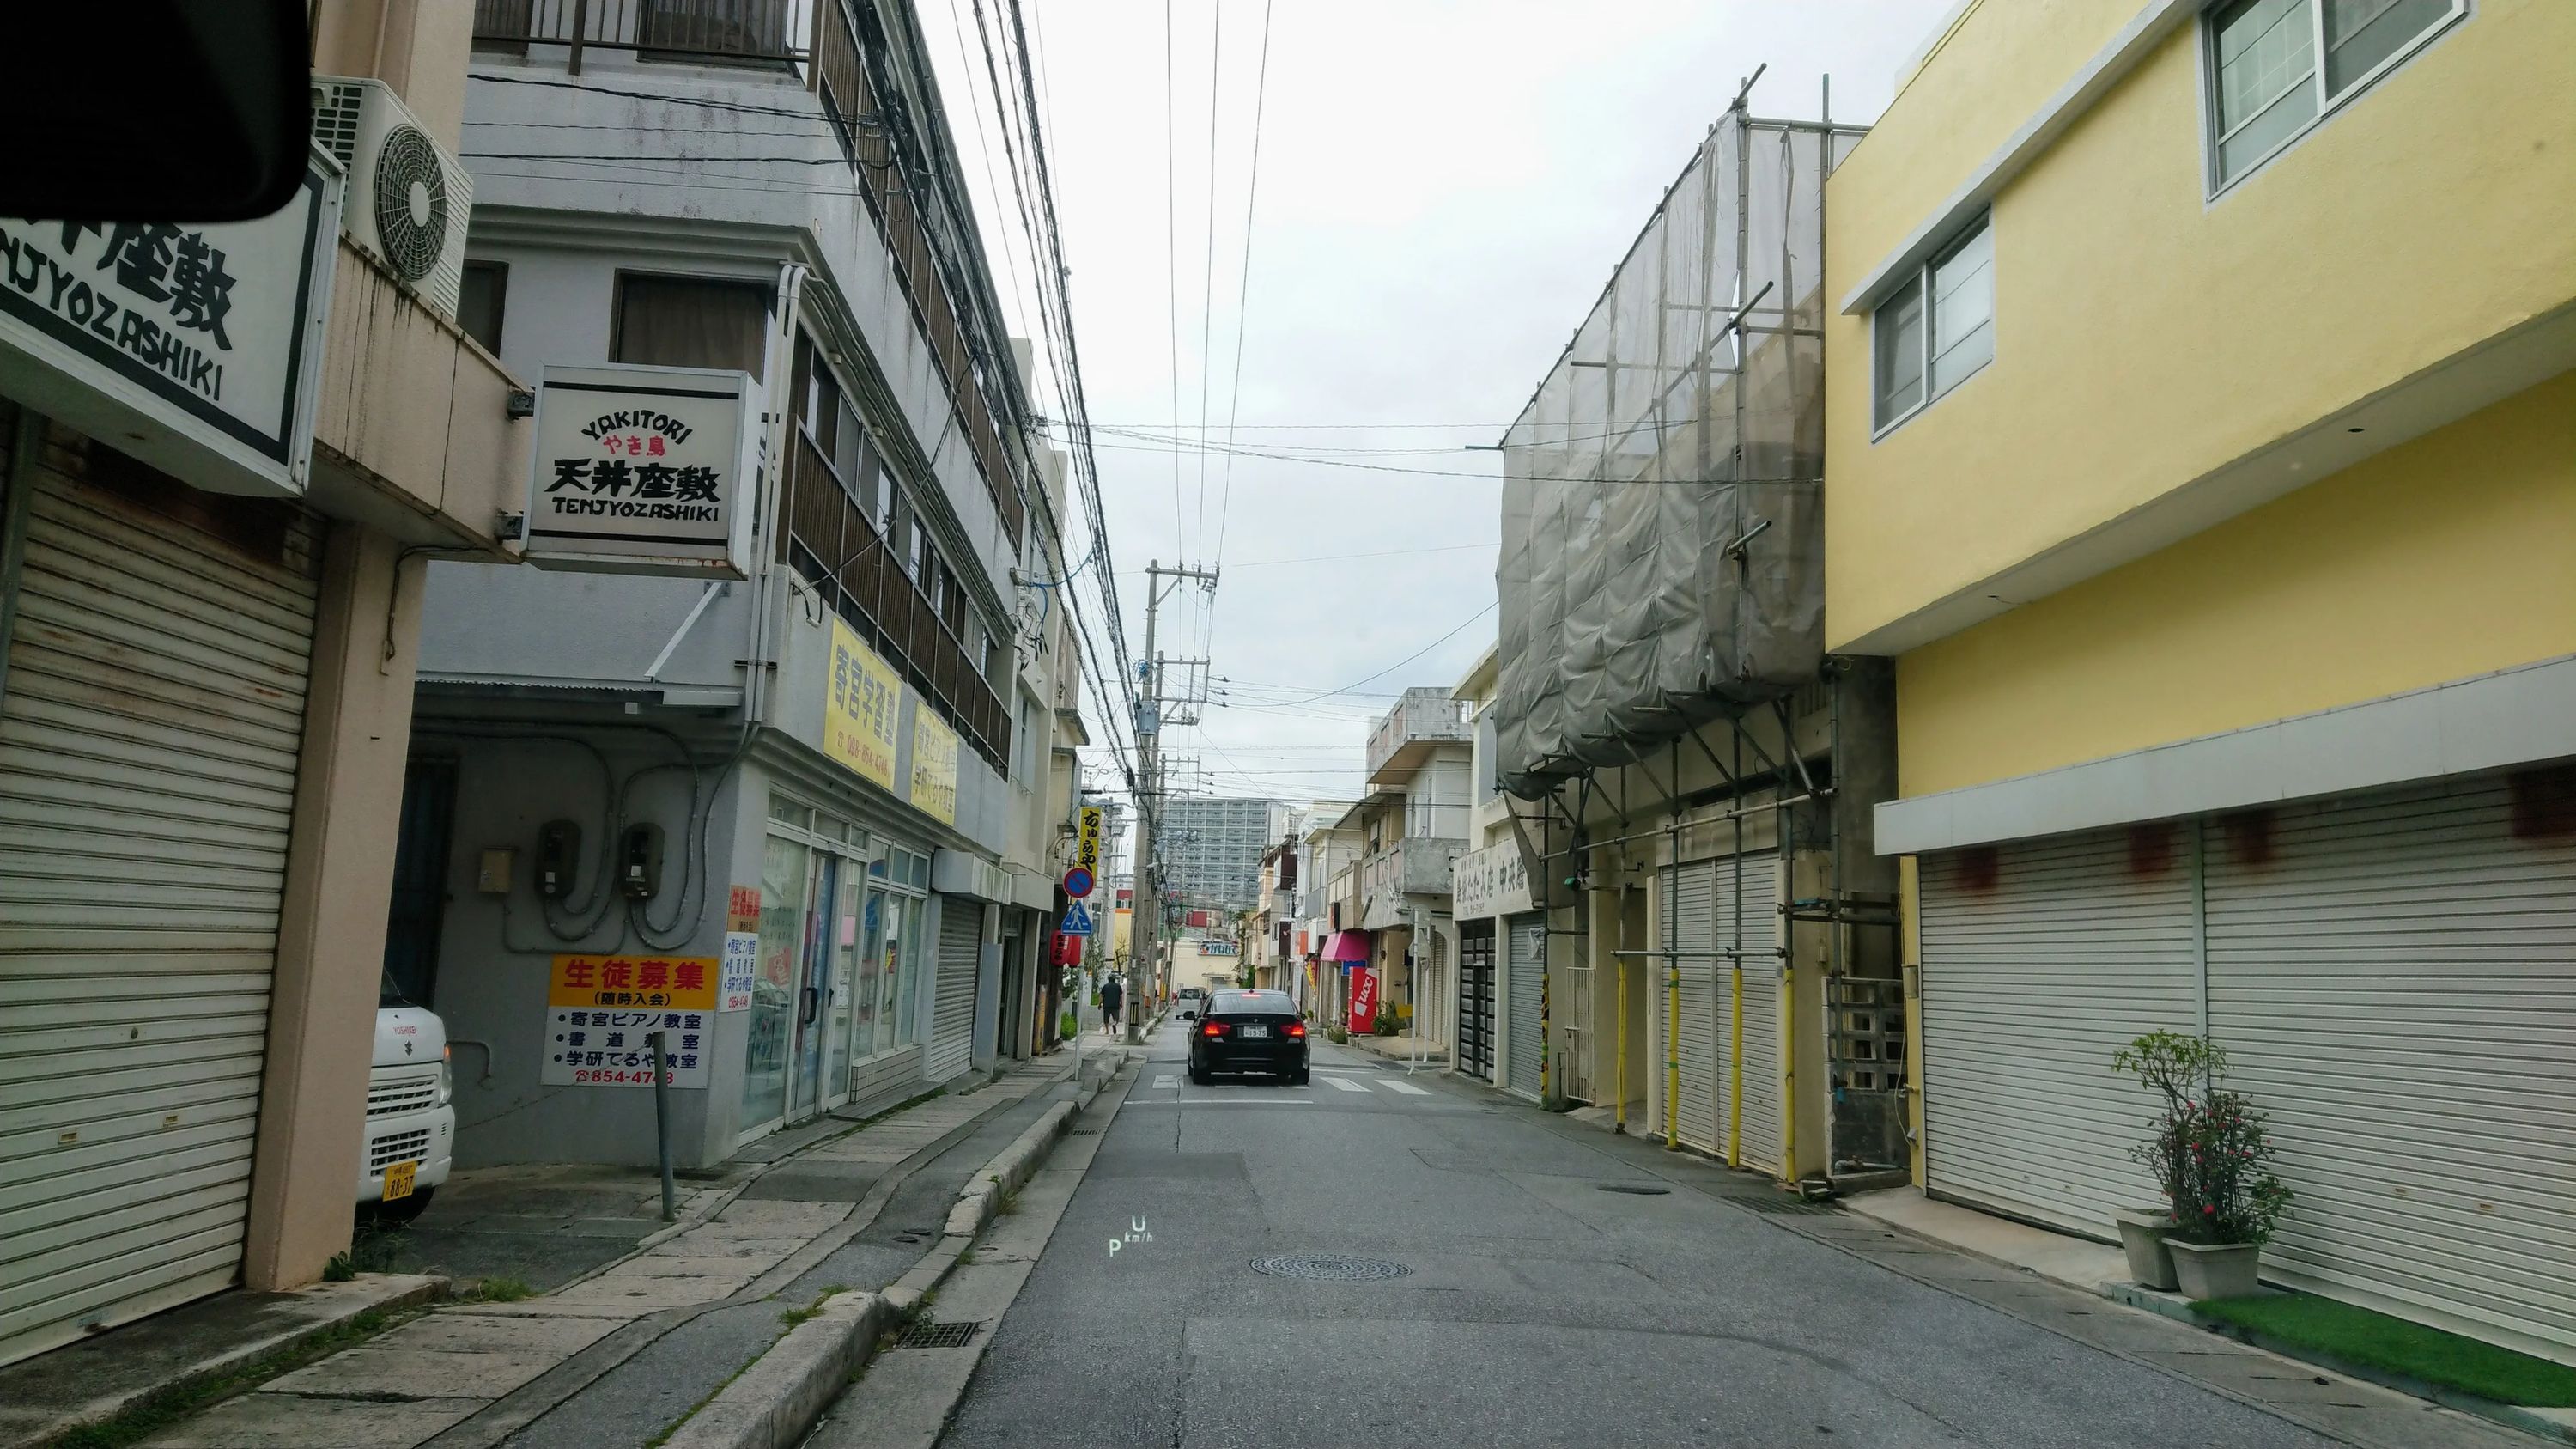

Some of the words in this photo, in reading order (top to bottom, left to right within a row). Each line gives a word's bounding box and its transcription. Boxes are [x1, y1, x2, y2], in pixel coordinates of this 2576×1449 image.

[581, 410, 693, 445] YAKITORI
[603, 435, 665, 456] やき鳥
[544, 458, 721, 502] 天井座敷
[552, 496, 719, 521] TENJYOZASHIKI
[835, 642, 896, 748] 寄宮学習塾
[564, 959, 704, 990] 生徒募集
[570, 1011, 702, 1030] 寄宮ピアノ教室
